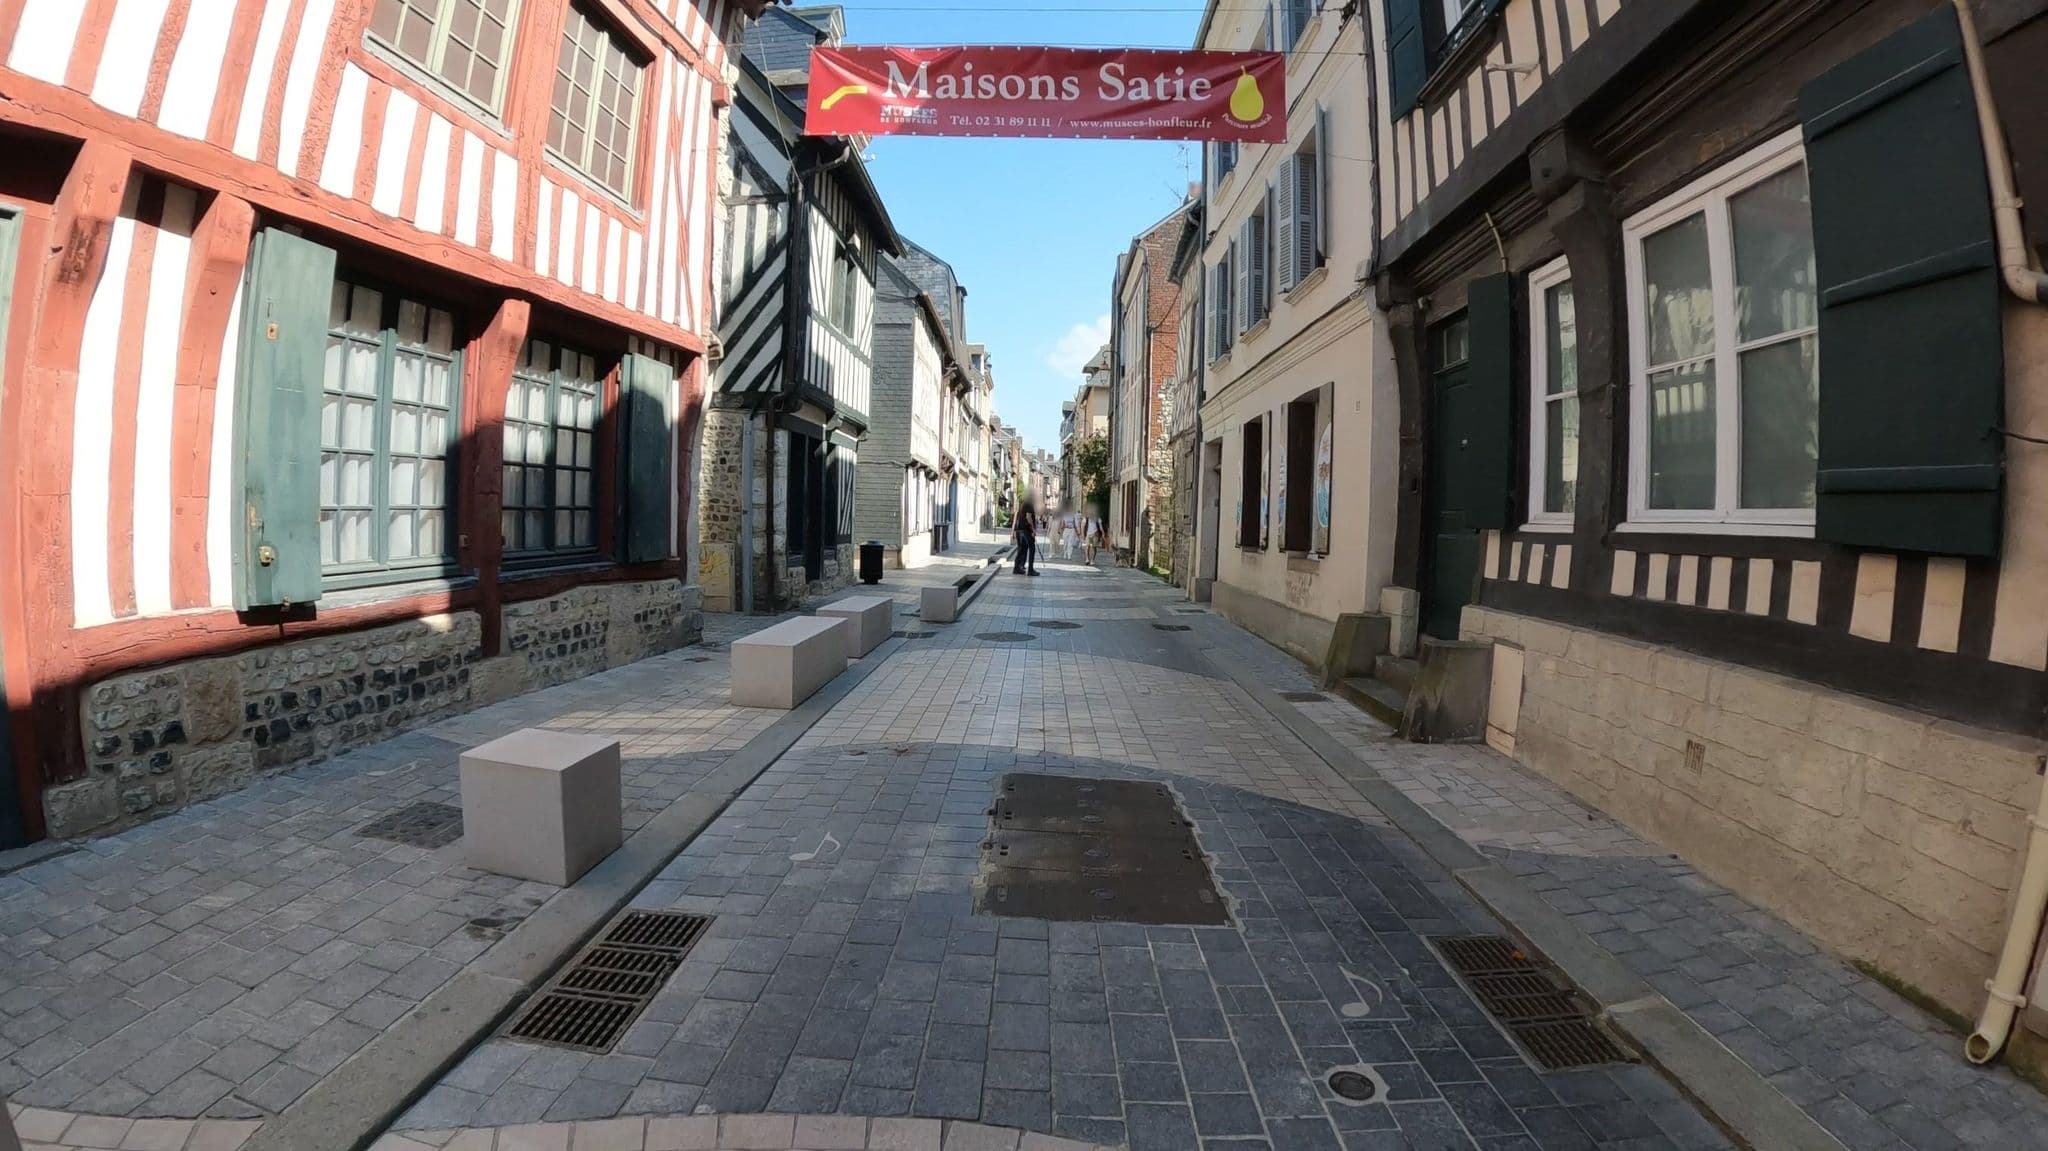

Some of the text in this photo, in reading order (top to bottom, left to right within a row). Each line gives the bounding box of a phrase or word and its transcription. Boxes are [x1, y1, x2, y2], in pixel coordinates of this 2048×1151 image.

[881, 60, 1212, 101] Maisons Satie
[950, 115, 972, 126] Tél.
[975, 116, 990, 126] 02
[994, 116, 1005, 126] 31
[1009, 116, 1024, 126] 89
[1028, 117, 1037, 127] 11
[1041, 117, 1050, 127] 11
